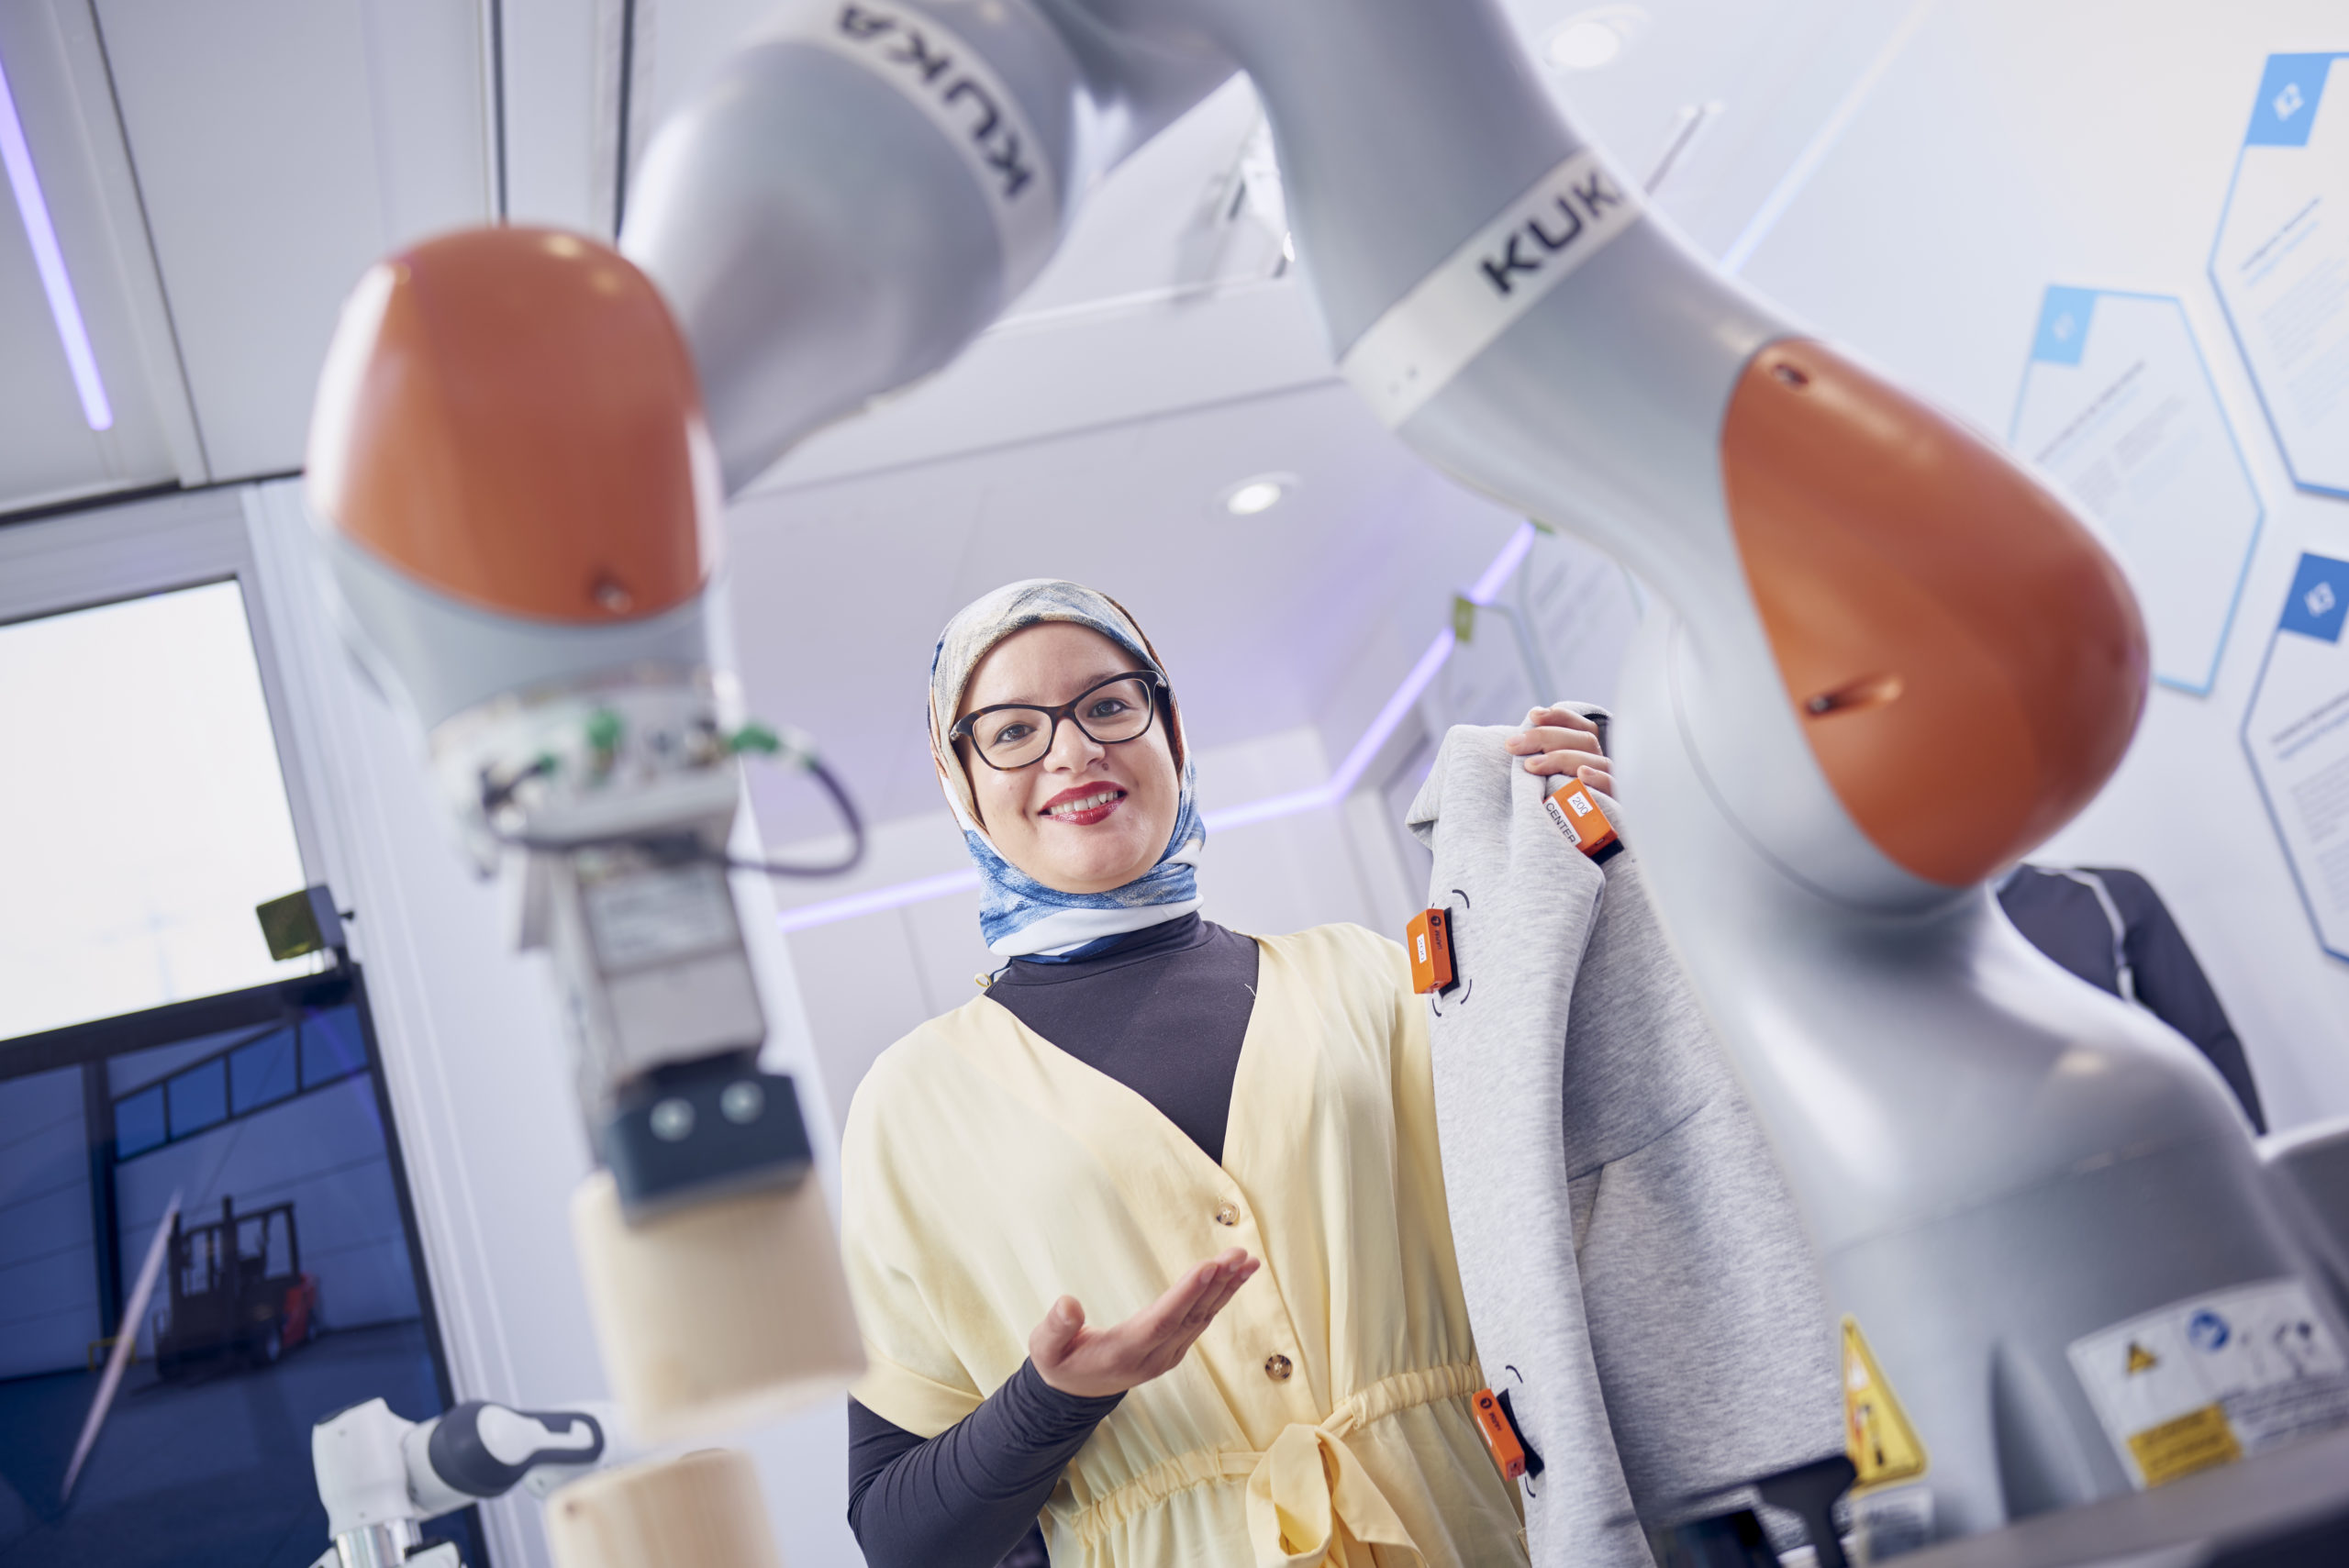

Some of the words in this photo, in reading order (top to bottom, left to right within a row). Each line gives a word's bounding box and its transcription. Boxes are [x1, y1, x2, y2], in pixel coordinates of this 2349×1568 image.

[838, 5, 1033, 198] KUKA
[1479, 172, 1627, 295] KUK
[1545, 802, 1576, 843] CENTER
[1572, 796, 1588, 815] 200
